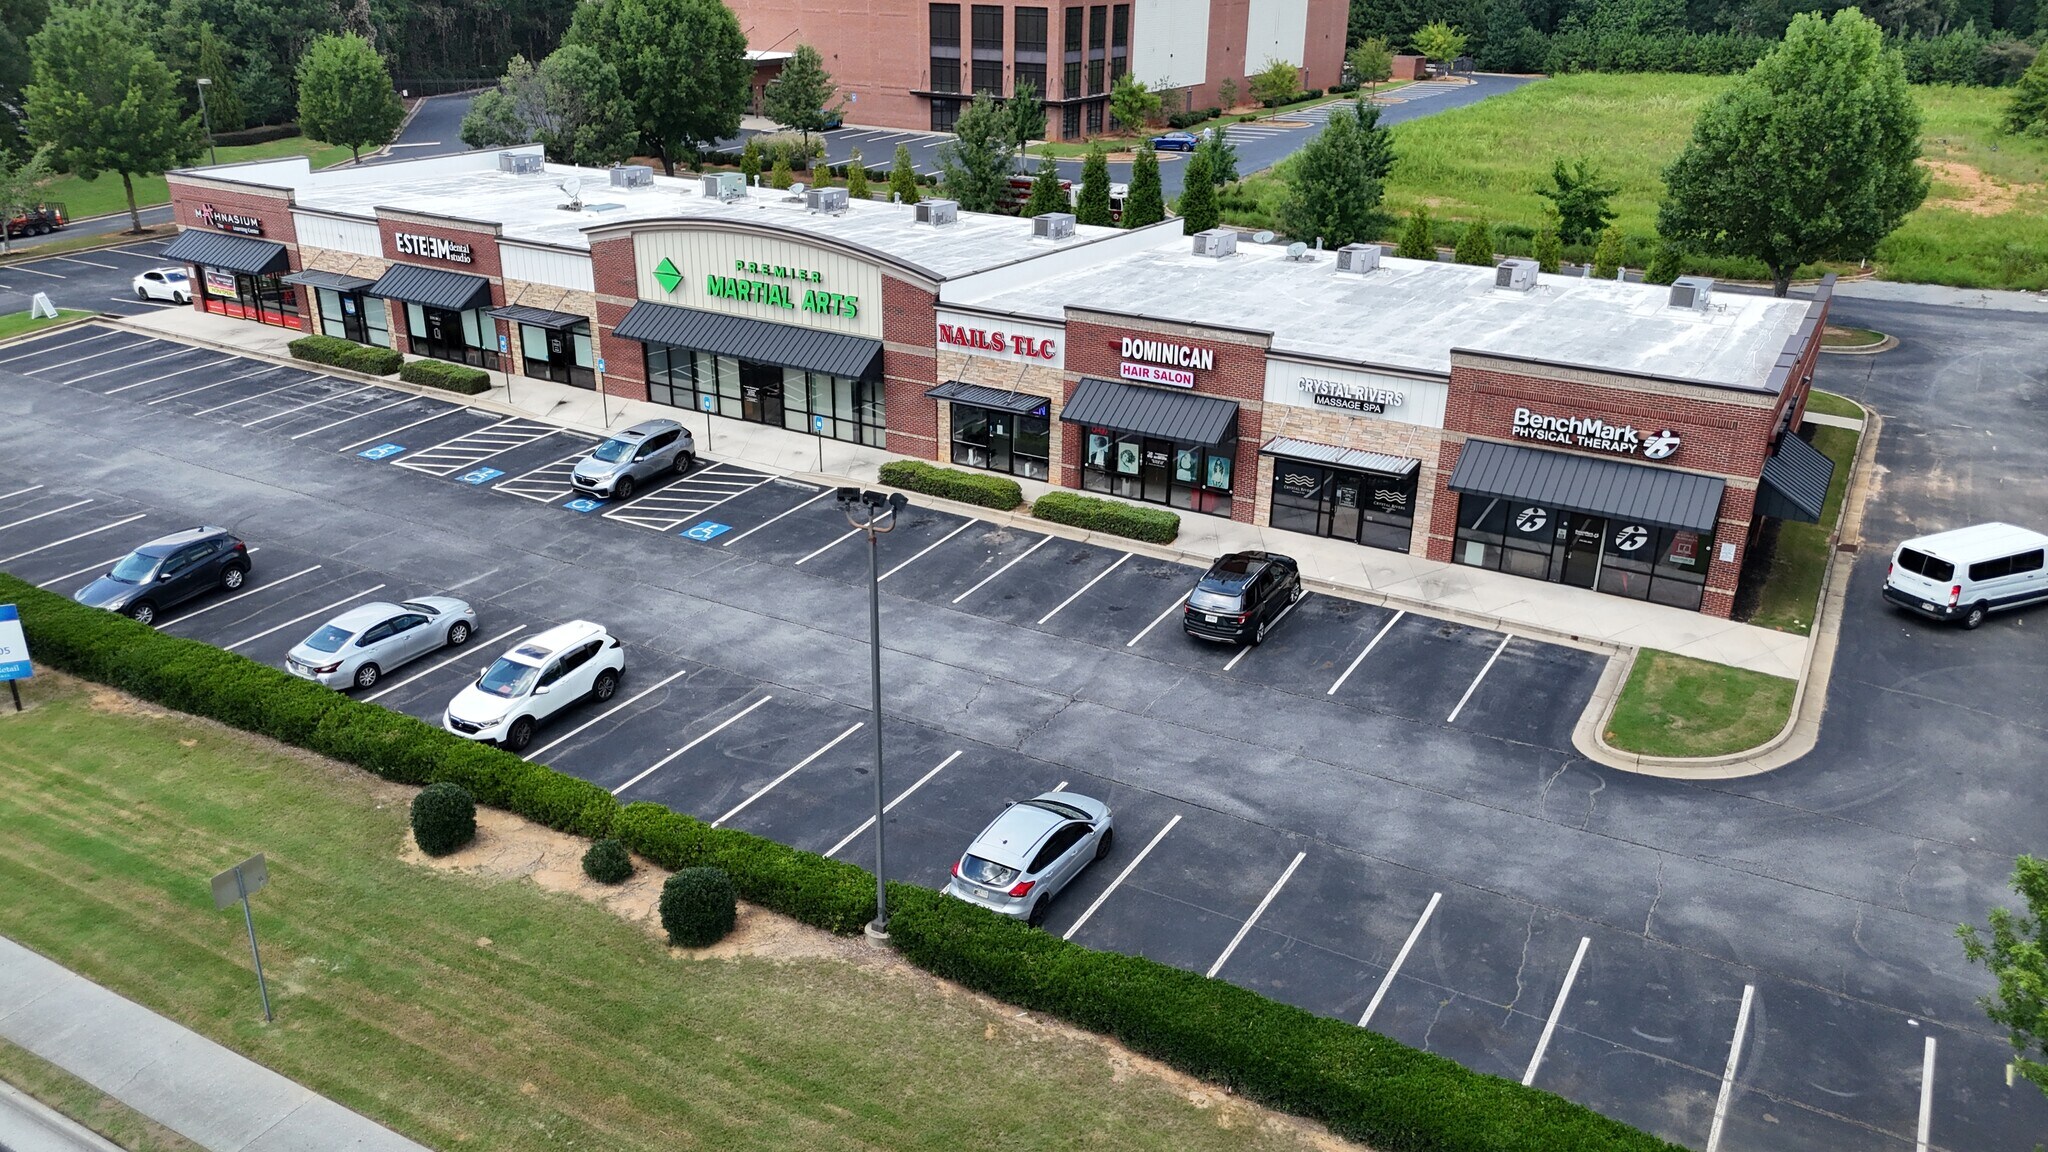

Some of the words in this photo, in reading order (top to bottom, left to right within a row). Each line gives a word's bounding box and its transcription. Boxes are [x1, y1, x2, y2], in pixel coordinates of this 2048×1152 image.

[195, 204, 259, 226] MATHNASIUM
[449, 241, 470, 254] dental
[450, 253, 471, 263] studio
[736, 260, 822, 284] PREMIER
[707, 275, 794, 310] MARTIAL
[802, 290, 858, 319] ARTS
[938, 324, 1005, 352] NAILS
[1011, 335, 1055, 360] TLC
[1121, 337, 1214, 370] DOMINICAN
[1123, 365, 1150, 378] HAIR
[1153, 369, 1191, 384] SALON
[1297, 378, 1352, 399] CRYSTAL
[1355, 386, 1404, 407] RIVERS
[1316, 396, 1361, 410] MASSAGE
[1363, 403, 1381, 413] SPA
[1513, 407, 1639, 444] BenchMark
[1512, 425, 1573, 444] PHYSICAL
[1577, 435, 1638, 454] THERAPY
[0, 664, 20, 673] etail
